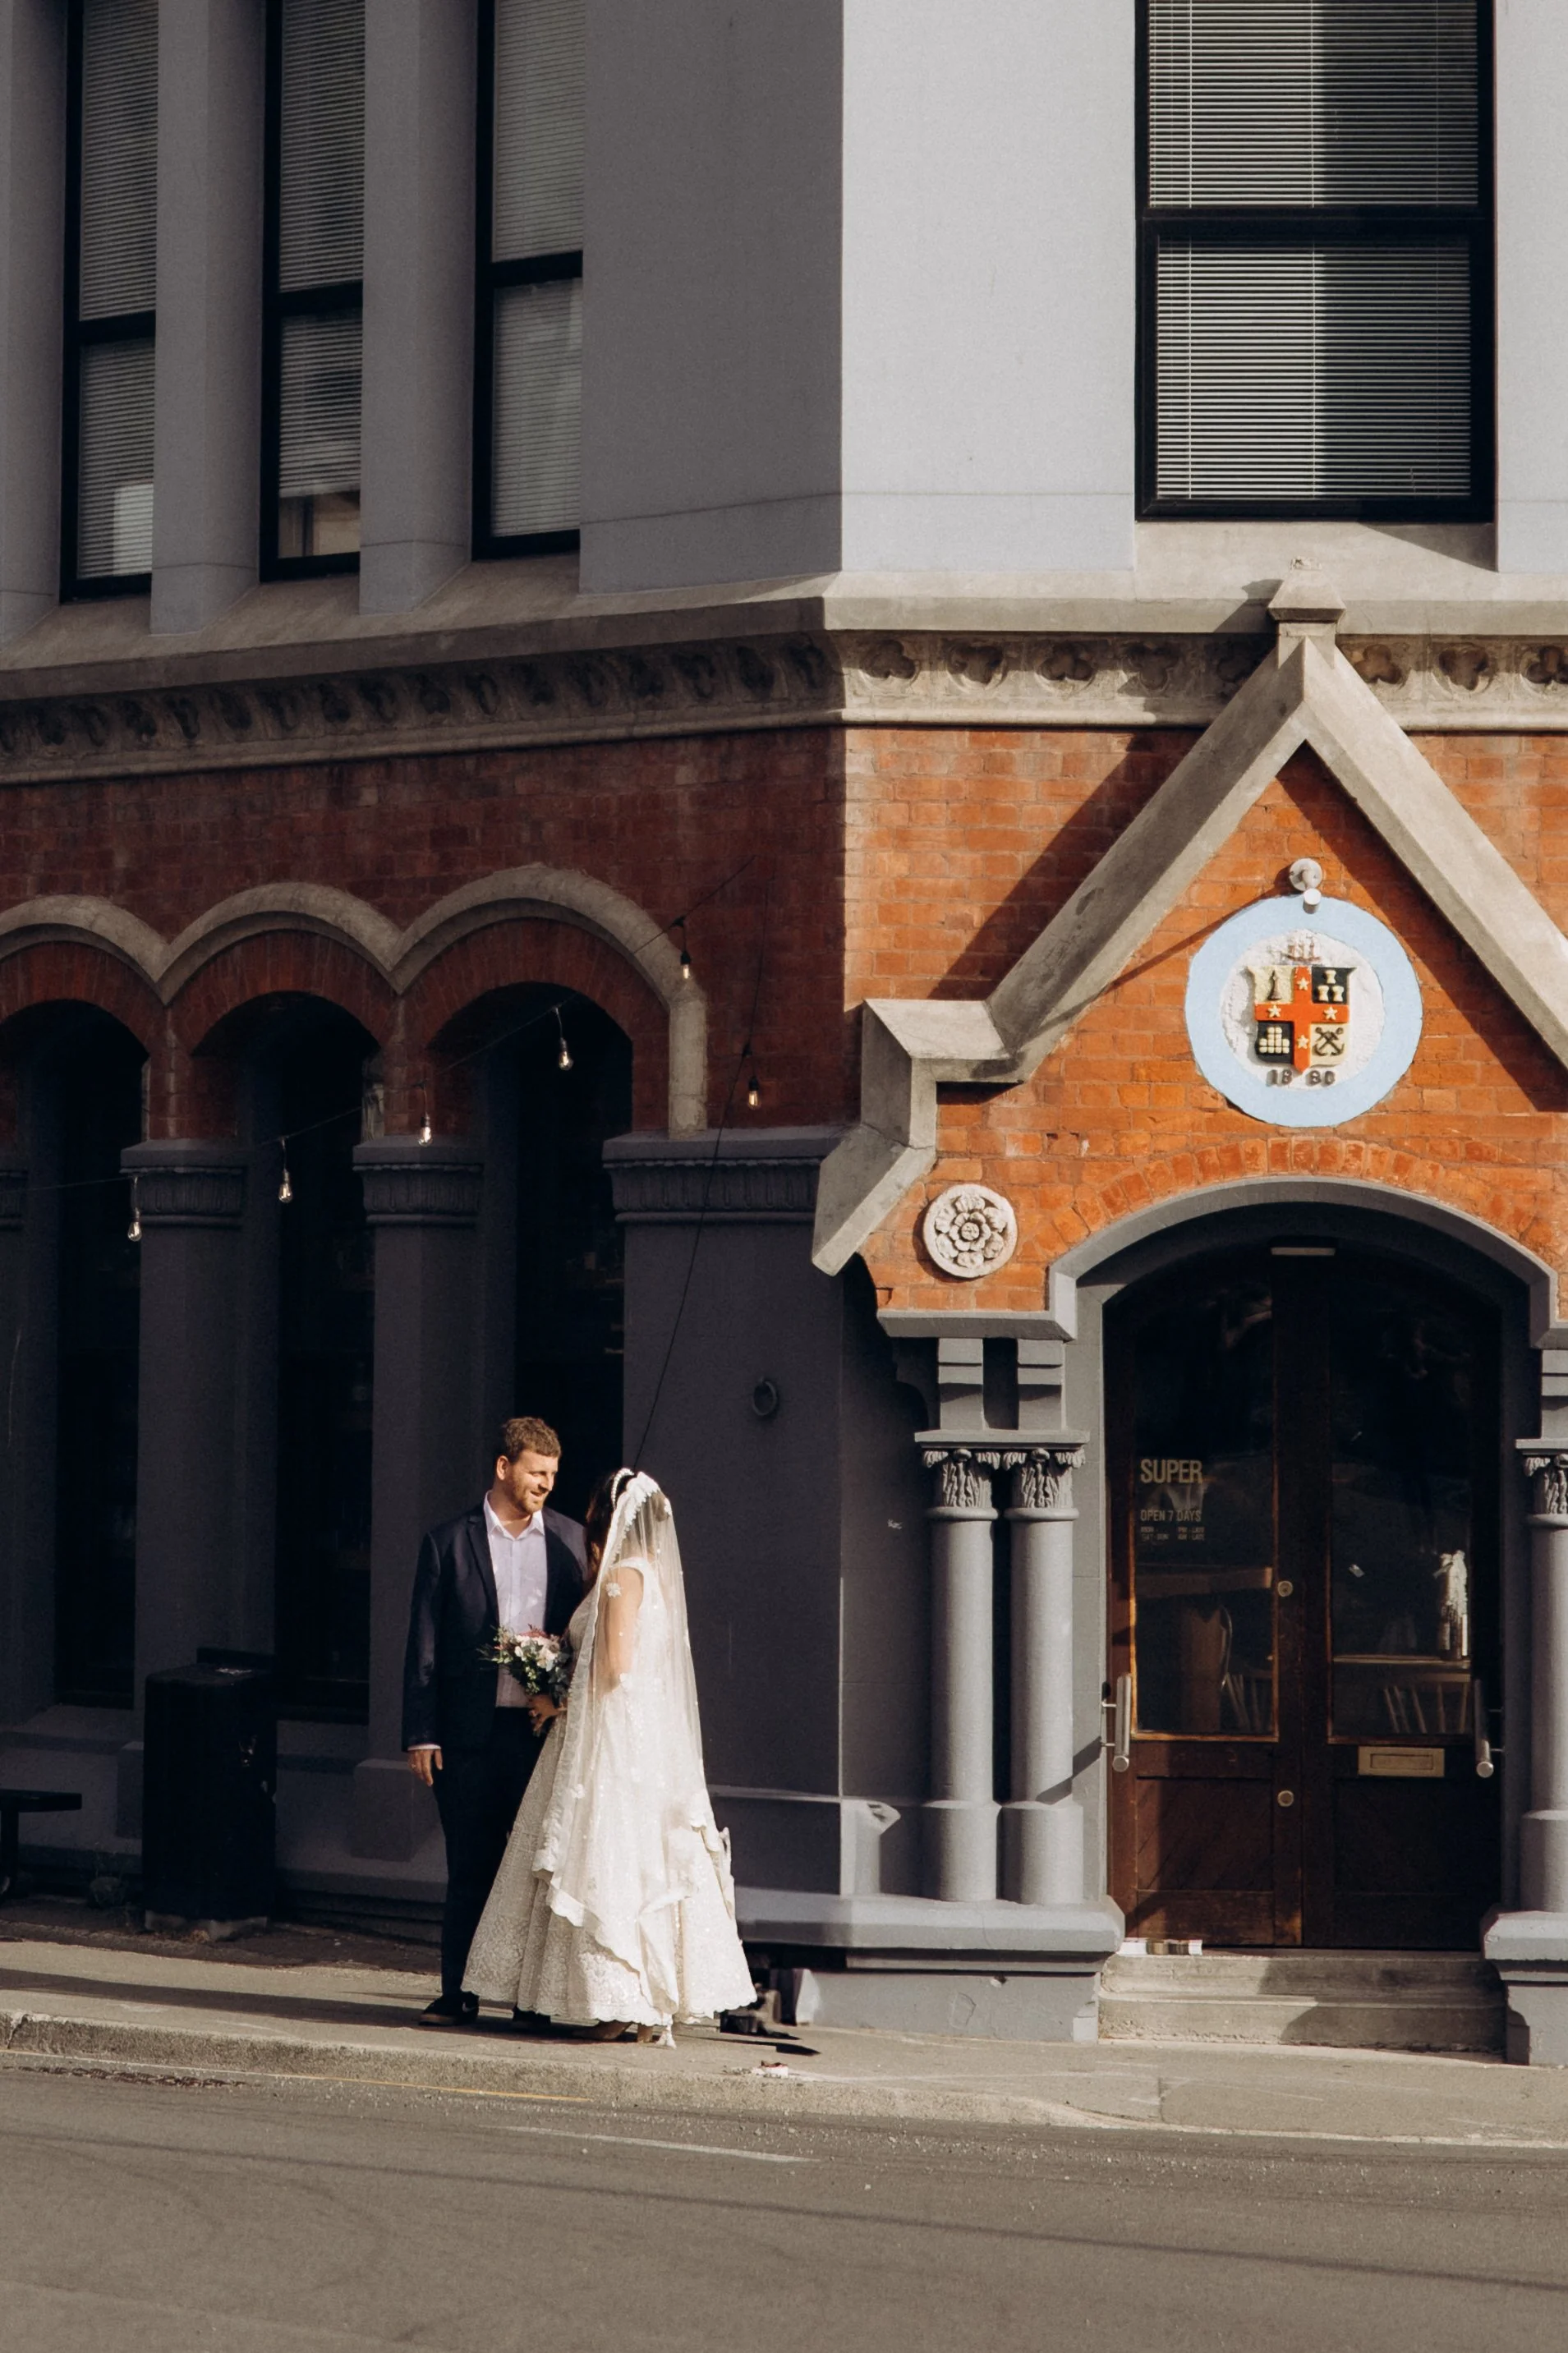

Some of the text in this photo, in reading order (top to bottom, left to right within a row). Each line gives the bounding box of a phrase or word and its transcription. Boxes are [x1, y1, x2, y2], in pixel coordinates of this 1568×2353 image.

[1140, 1459, 1202, 1483] SUPER
[1140, 1510, 1201, 1522] OPEN 7 DAYS
